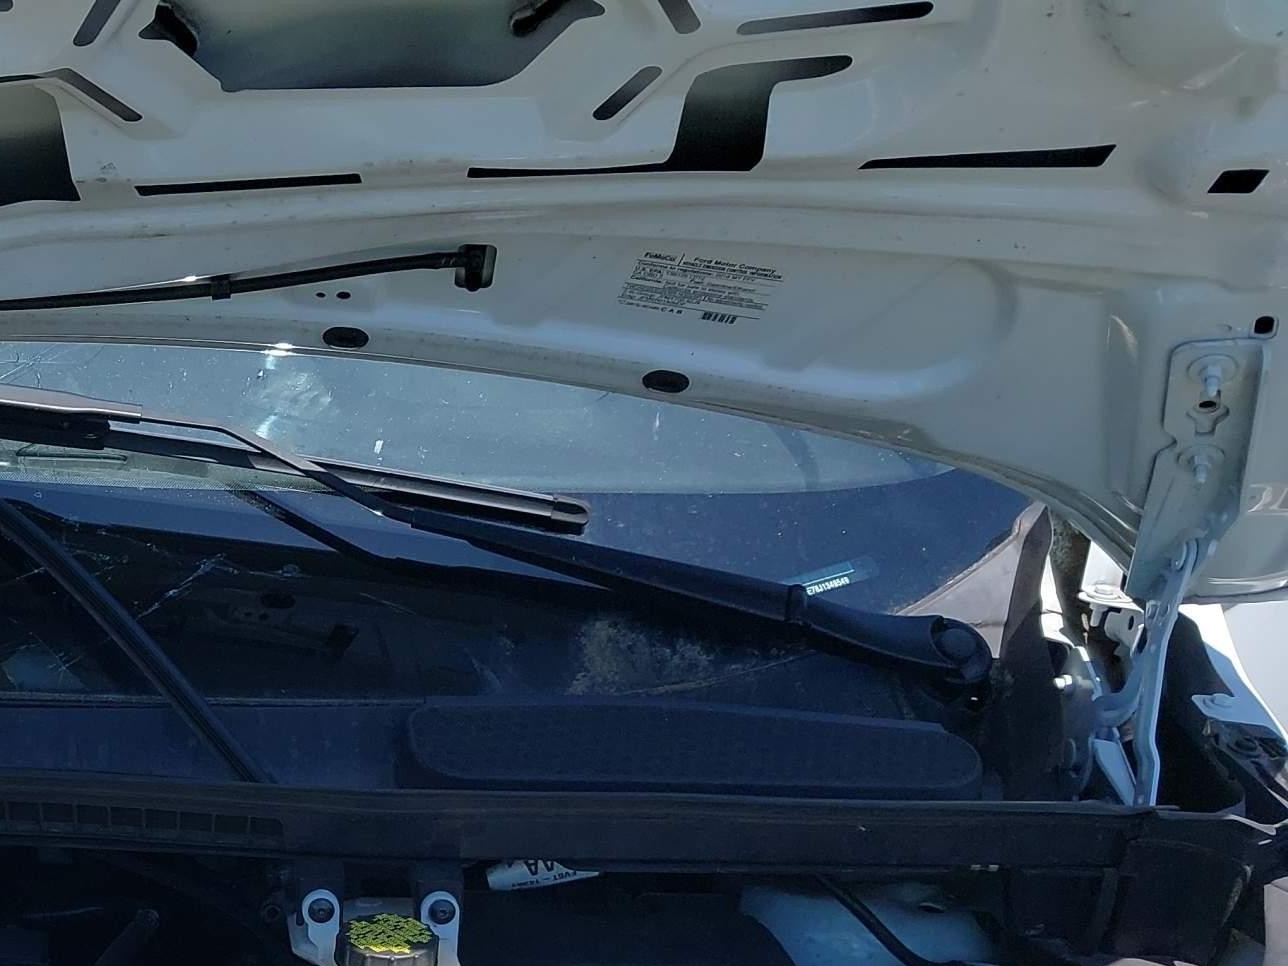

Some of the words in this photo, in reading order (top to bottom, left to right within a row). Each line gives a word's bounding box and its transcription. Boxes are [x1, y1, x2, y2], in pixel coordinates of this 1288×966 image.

[693, 256, 712, 264] Ford
[714, 259, 737, 268] Motor
[739, 262, 777, 274] Company
